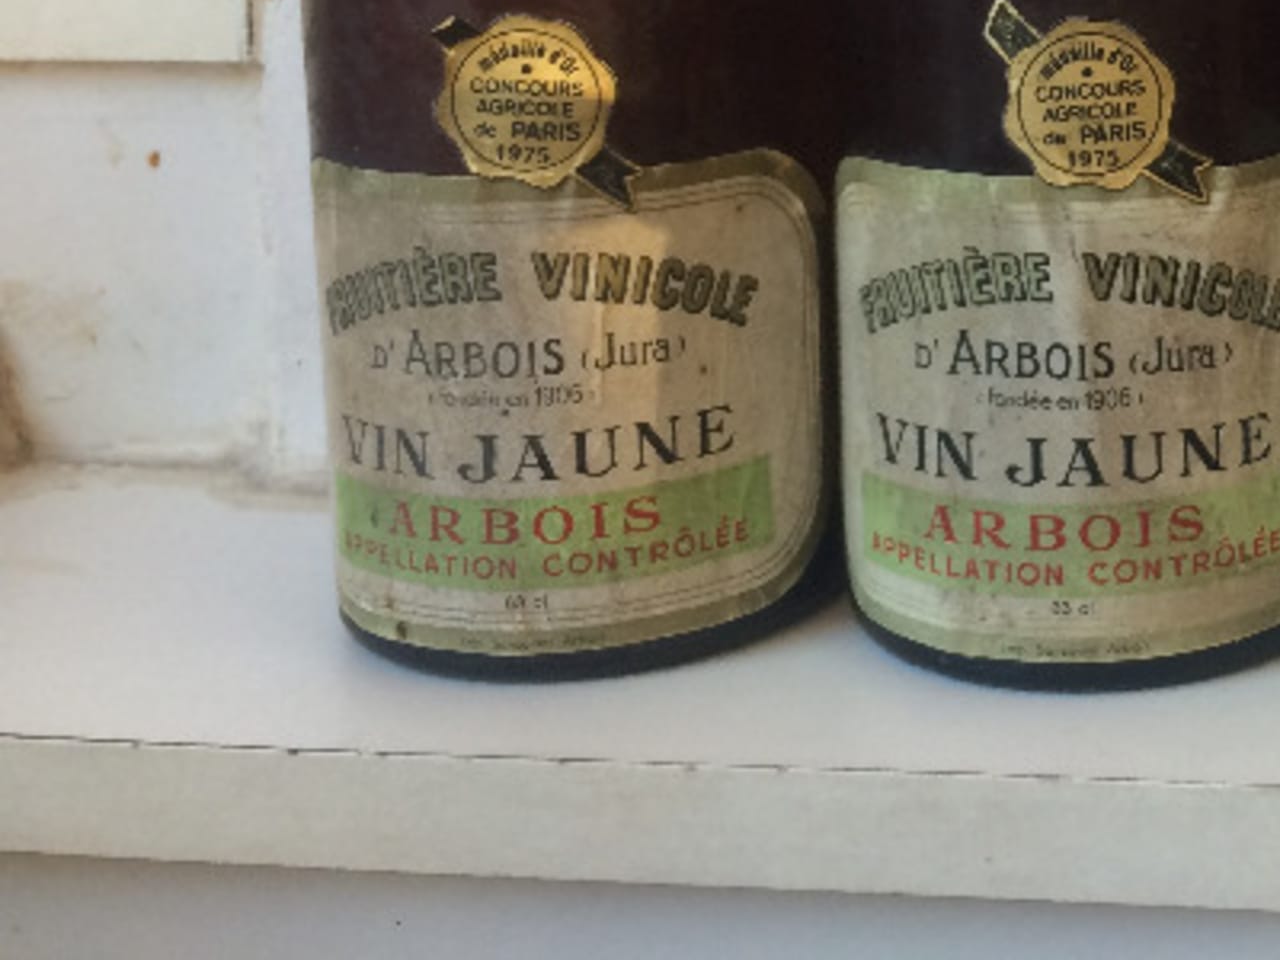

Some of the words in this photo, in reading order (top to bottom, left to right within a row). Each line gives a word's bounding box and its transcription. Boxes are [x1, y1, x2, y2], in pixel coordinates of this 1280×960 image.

[470, 77, 583, 97] CONCOURS
[1034, 79, 1146, 103] CONCOURS
[476, 99, 574, 118] AGRICOLE
[1043, 102, 1137, 123] AGRICOLE
[511, 121, 582, 141] PARIS
[1081, 121, 1147, 144] PARIS
[497, 144, 550, 164] 1975
[1068, 150, 1120, 168] 1975
[532, 252, 759, 327] VINICOLE
[859, 246, 1053, 334] FRUITIÈRE
[342, 414, 436, 481] VIN
[458, 403, 735, 484] JAUNE
[877, 412, 979, 481] VIN
[1005, 412, 1271, 488] JAUNE
[388, 495, 663, 545] ARBOIS
[923, 504, 1206, 553] ARBOIS
[543, 515, 750, 577] CONTRÔLÉE
[873, 530, 1065, 587] APPELLATION
